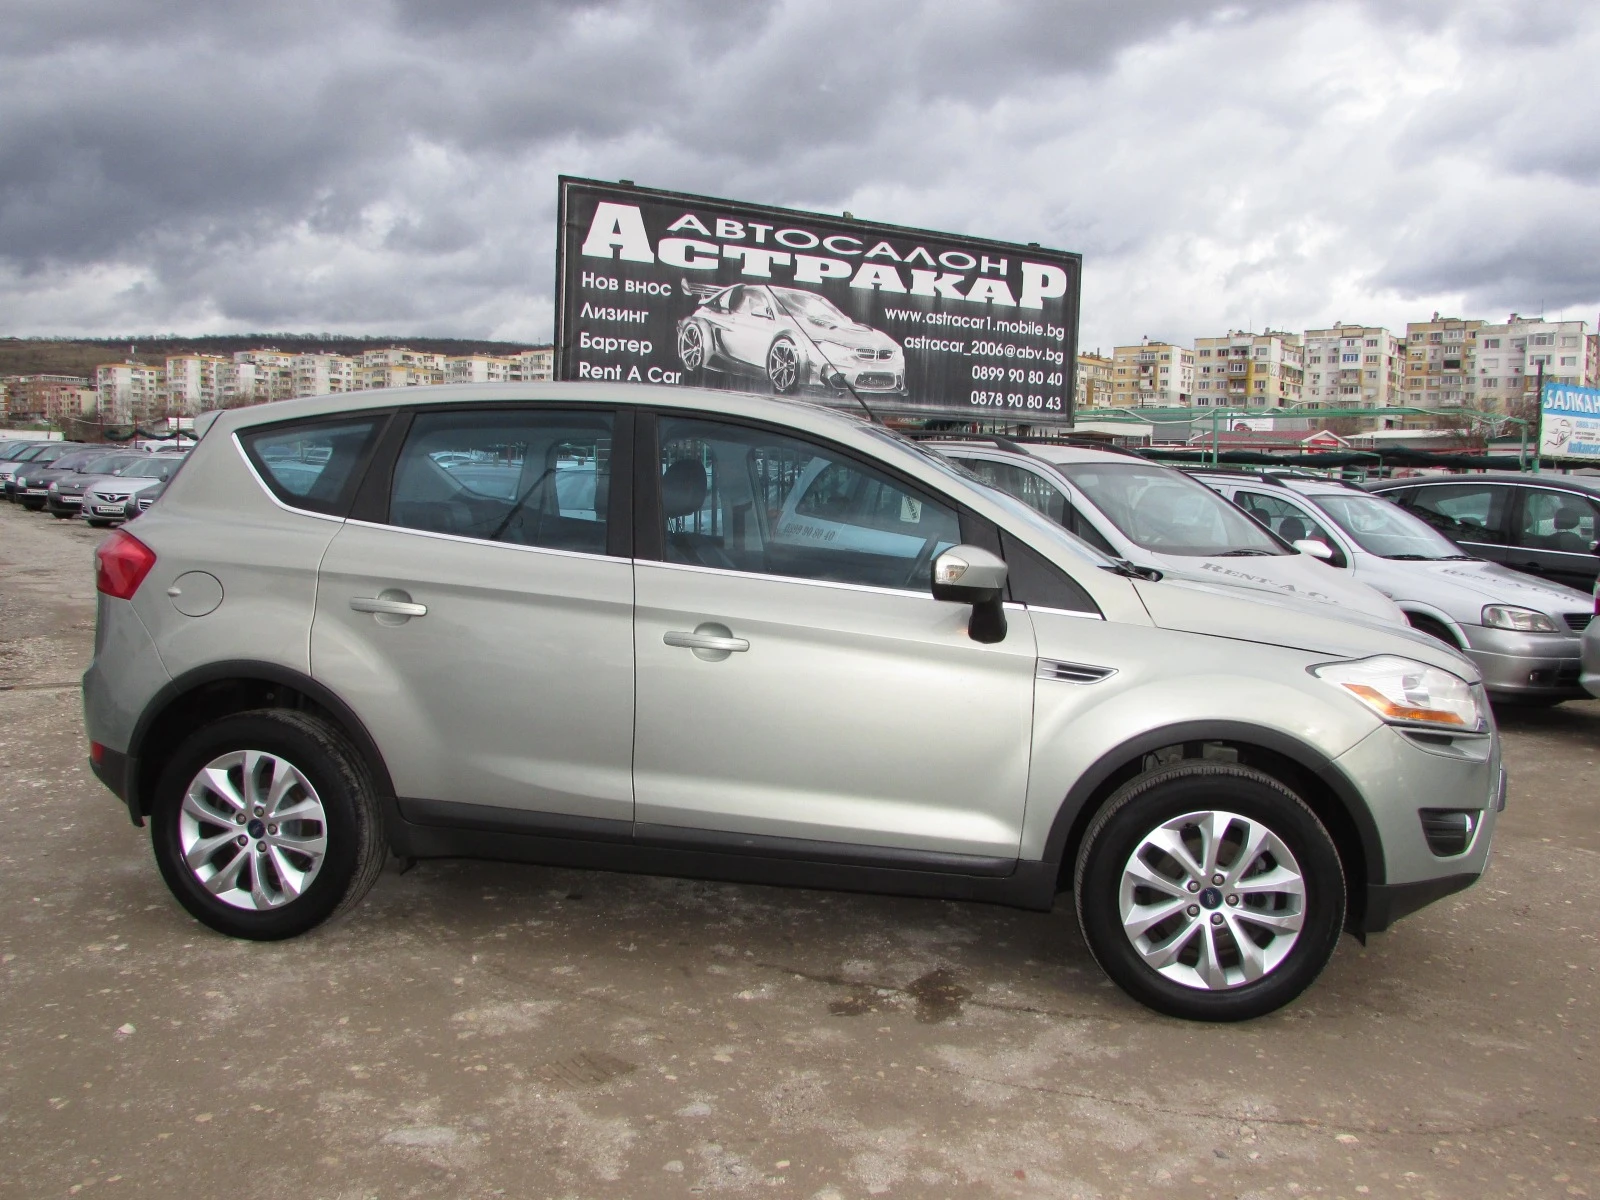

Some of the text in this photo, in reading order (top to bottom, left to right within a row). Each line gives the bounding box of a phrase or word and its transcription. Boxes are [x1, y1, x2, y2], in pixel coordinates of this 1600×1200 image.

[581, 201, 1068, 310] АСТРАКАР
[666, 213, 1008, 276] АВТОСАЛОН
[582, 271, 672, 297] Нов внос
[580, 301, 649, 324] Лизинг
[884, 307, 1065, 341] www.astracar1.mobile.bg
[580, 331, 653, 356] Бартер
[904, 335, 1064, 365] astracar_2006@abv.bg
[579, 361, 682, 384] Rent A Car
[971, 365, 1063, 386] 0899 90 80 40
[970, 390, 1061, 410] 0878 90 80 43
